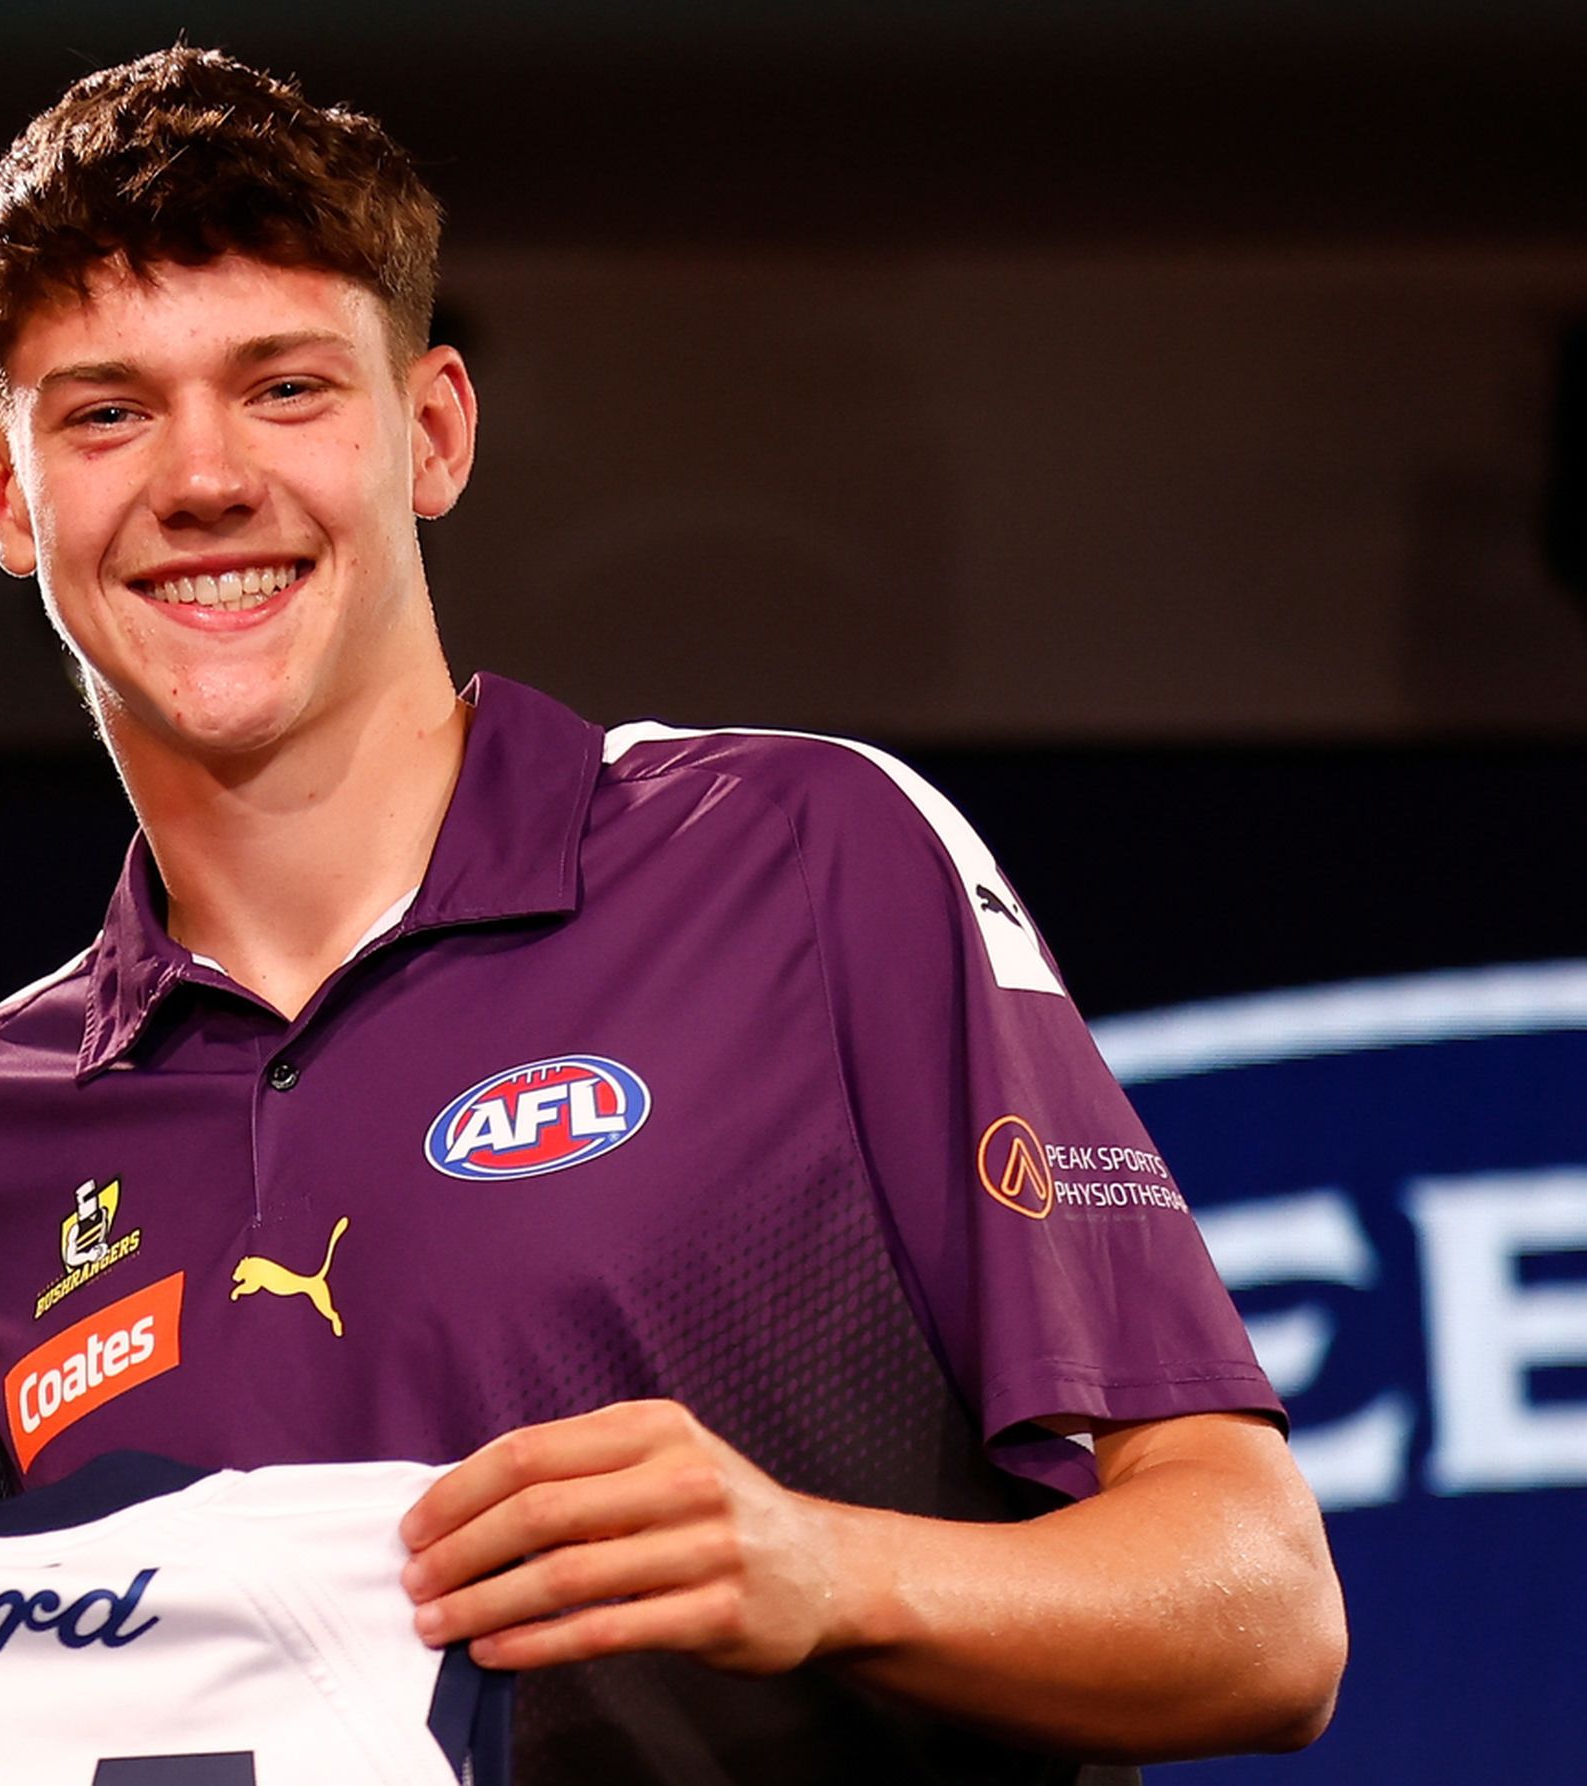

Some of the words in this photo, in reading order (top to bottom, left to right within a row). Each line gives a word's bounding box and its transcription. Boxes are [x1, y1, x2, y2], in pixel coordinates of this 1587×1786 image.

[444, 1077, 627, 1163] AFL
[1045, 1145, 1096, 1170] PEAK
[1097, 1147, 1168, 1179] SPORTS
[35, 1229, 140, 1319] BUSHRANGERS
[19, 1315, 155, 1433] Coates
